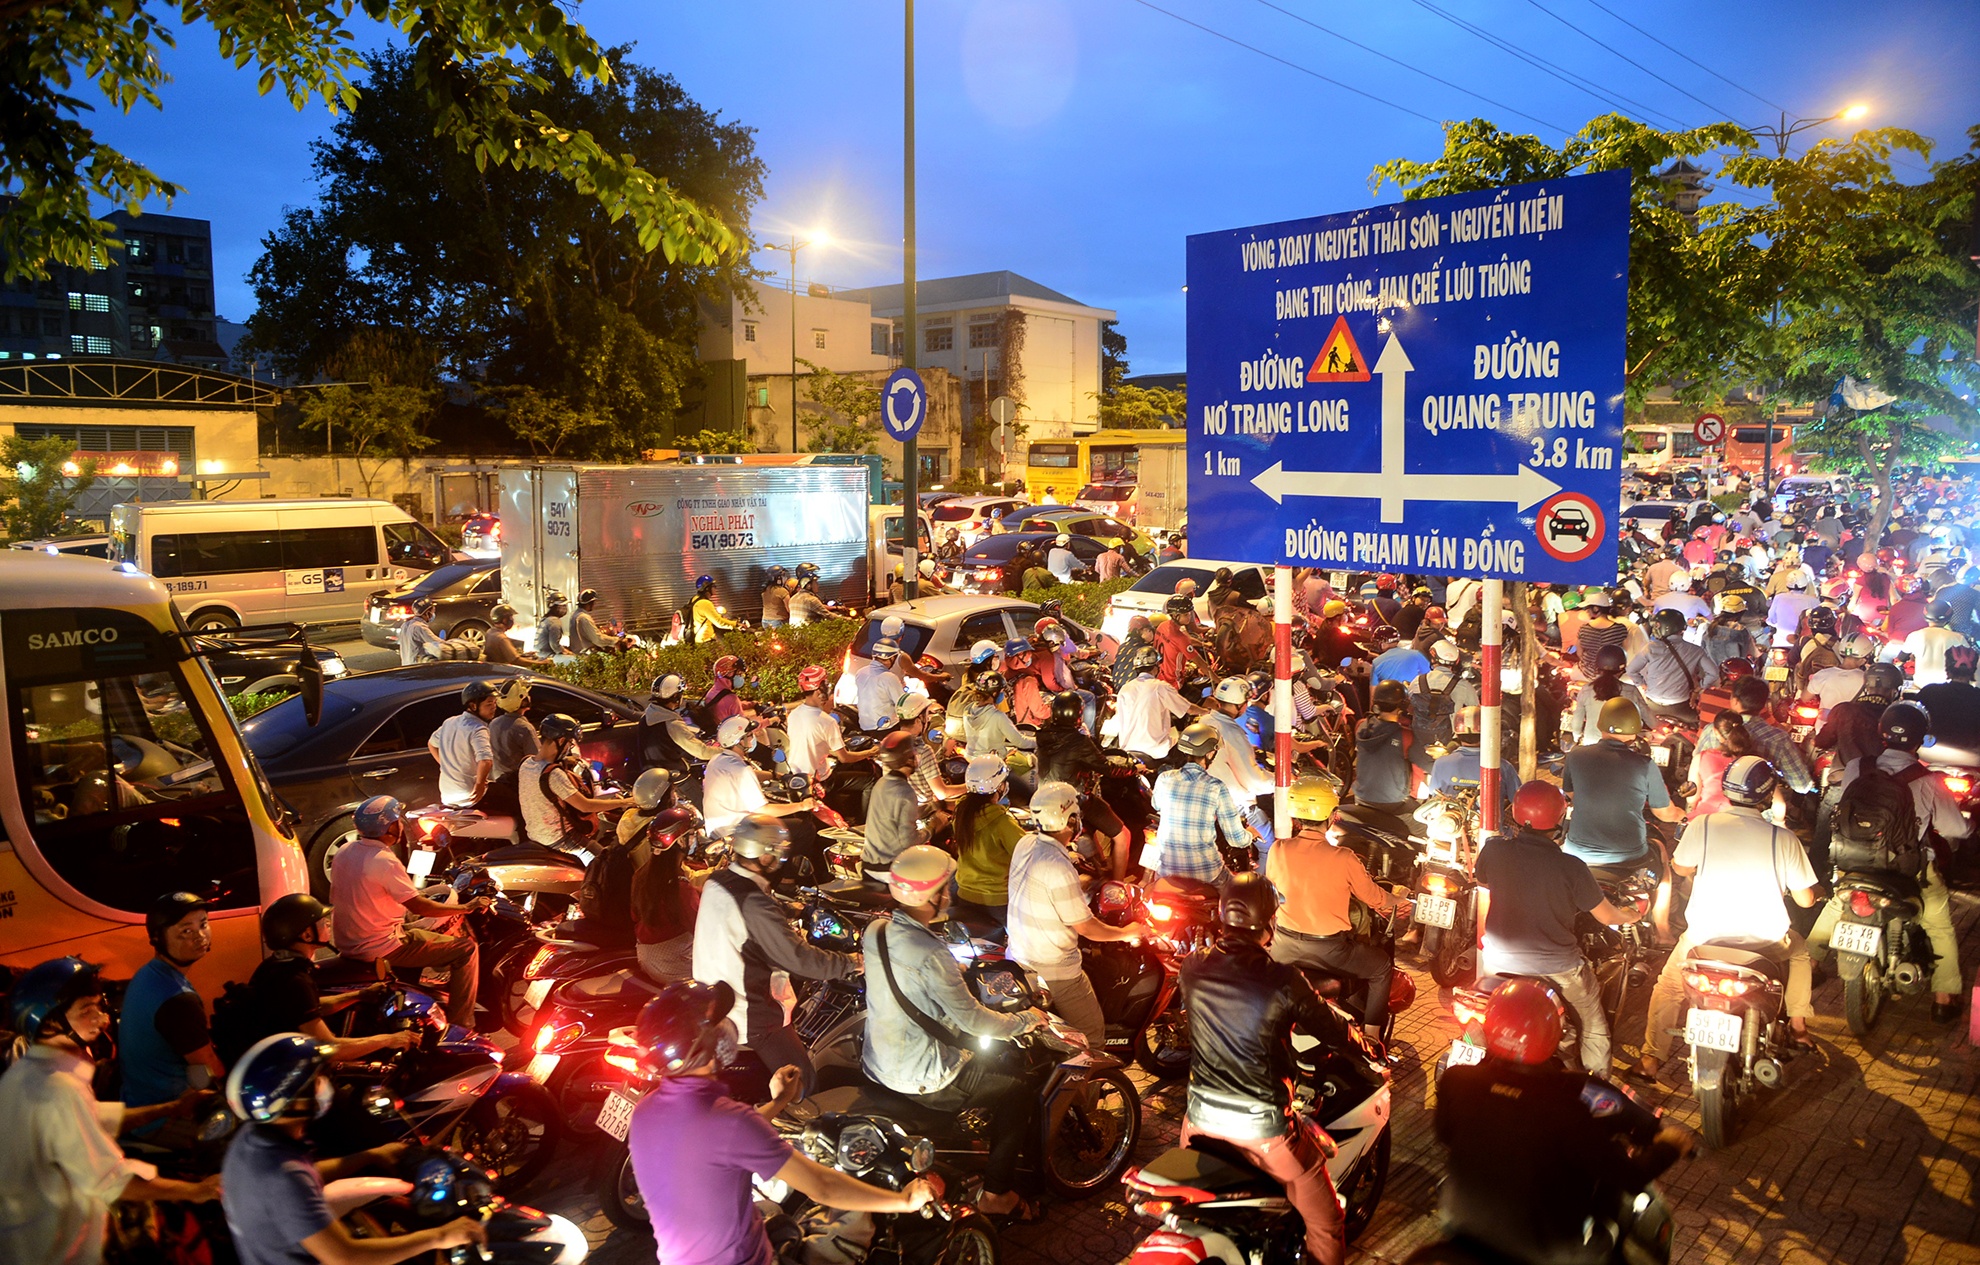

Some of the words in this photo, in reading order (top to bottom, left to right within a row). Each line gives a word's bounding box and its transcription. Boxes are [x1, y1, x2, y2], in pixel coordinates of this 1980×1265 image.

[1241, 234, 1275, 272] VÒNG
[1278, 233, 1312, 268] XOAY
[1315, 212, 1369, 263] NGUYỄN
[1373, 211, 1406, 254] THÁI
[1410, 209, 1439, 250] SƠN
[1451, 189, 1514, 243] NGUYỄN
[1519, 188, 1564, 241] KIỆM
[1276, 286, 1309, 320] ĐANG
[1312, 284, 1333, 316] THI
[1379, 275, 1409, 316] HẠN
[1412, 256, 1443, 306] CHẾ
[1445, 261, 1474, 302] LƯU
[1478, 253, 1531, 298] THÔNG
[1240, 348, 1304, 392] ĐƯỜNG
[1473, 330, 1560, 380] ĐƯỜNG
[1203, 400, 1229, 435] NƠ
[1231, 402, 1292, 434] TRANG
[1297, 398, 1349, 433] LONG
[1422, 393, 1501, 436] QUANG
[1507, 390, 1596, 429] TRUNG
[1204, 450, 1213, 476] 1
[1217, 450, 1241, 476] km
[1529, 436, 1568, 468] 3.8
[1575, 438, 1613, 470] km
[550, 502, 568, 518] 54Y
[728, 509, 755, 530] PHÁT
[1285, 518, 1348, 562] ĐƯỜNG
[1353, 532, 1409, 571] PHẠM
[1415, 529, 1457, 569] VĂN
[1463, 523, 1525, 574] ĐỒNG
[302, 573, 323, 585] GS
[28, 627, 118, 650] SAMCO
[1837, 935, 1871, 952] 8816
